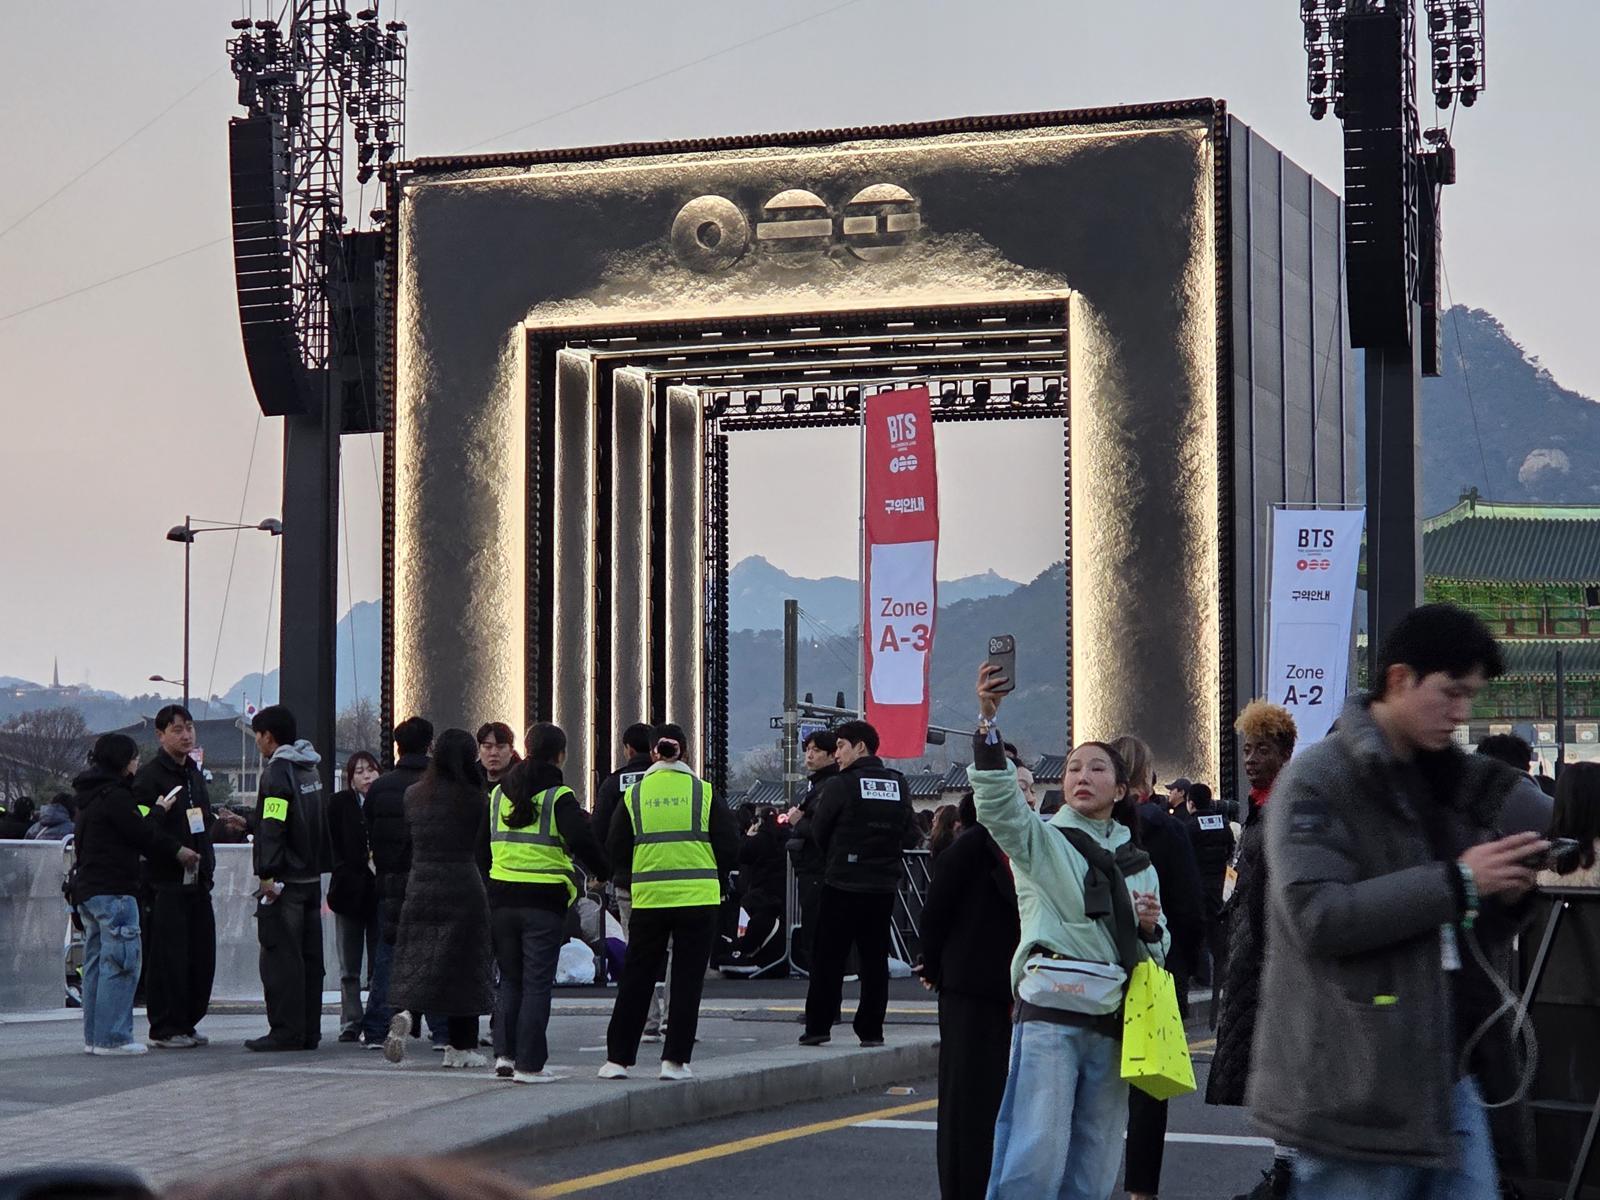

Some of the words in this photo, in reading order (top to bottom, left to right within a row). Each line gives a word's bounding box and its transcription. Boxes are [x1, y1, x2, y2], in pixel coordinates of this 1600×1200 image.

[886, 412, 917, 443] BTS
[885, 496, 925, 514] 구역안내
[1298, 528, 1335, 548] BTS
[1292, 590, 1330, 601] 구역안내
[881, 597, 928, 617] Zone
[879, 623, 930, 652] A-3
[1286, 664, 1324, 680] Zone
[1282, 685, 1323, 705] A-2
[645, 796, 689, 808] 서울특별시
